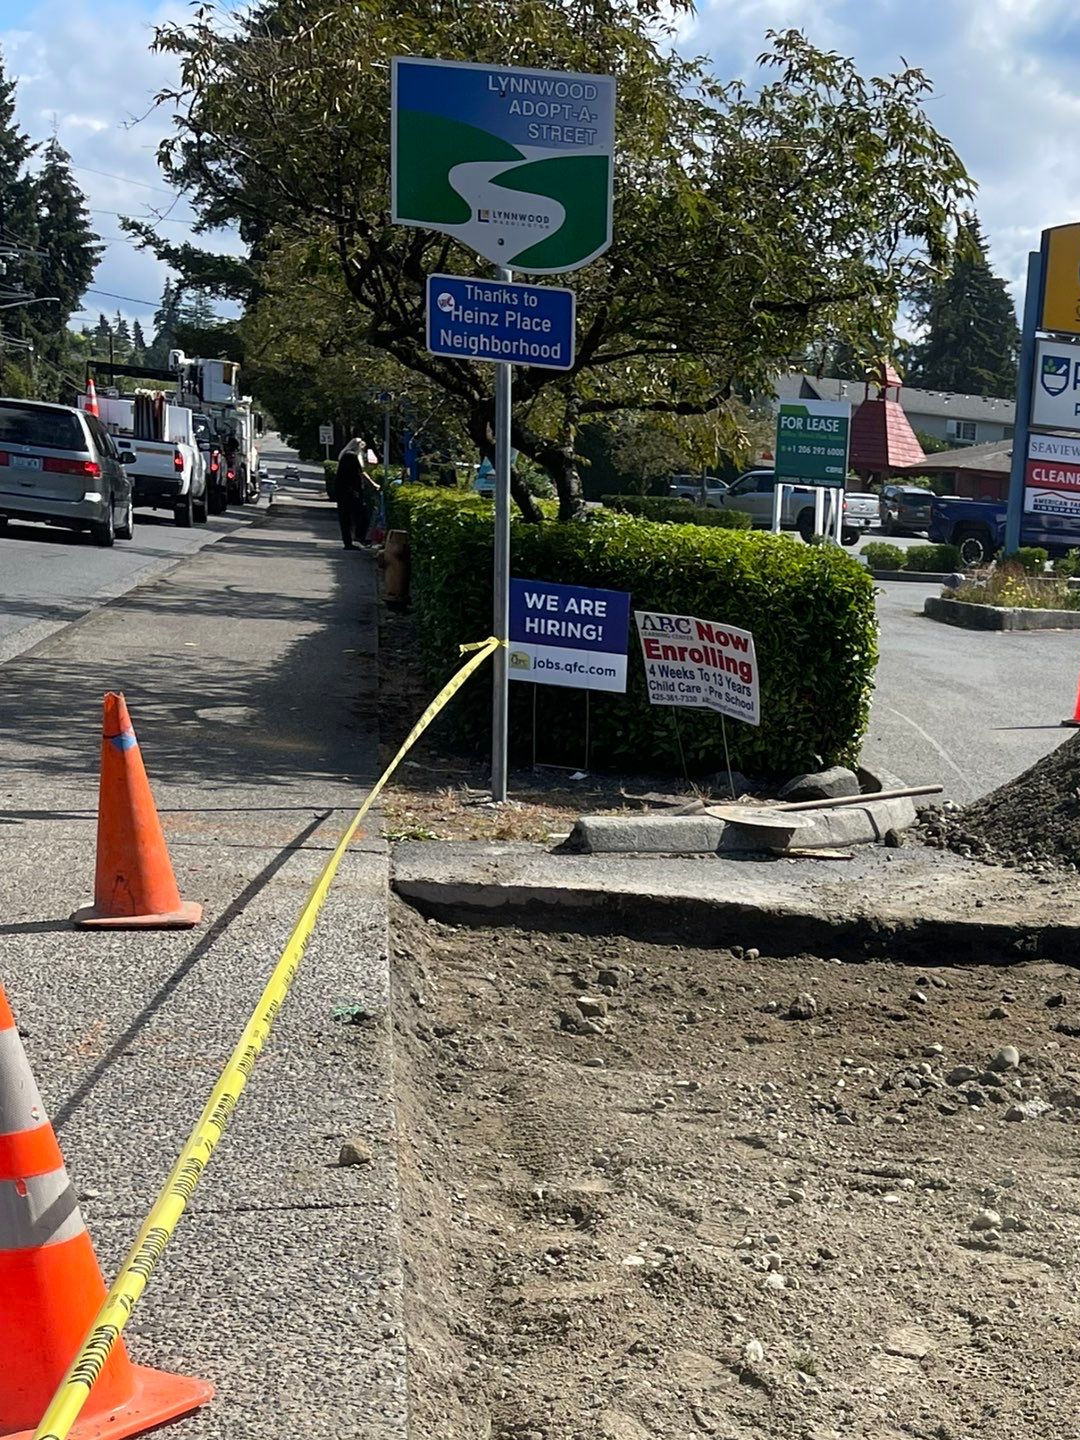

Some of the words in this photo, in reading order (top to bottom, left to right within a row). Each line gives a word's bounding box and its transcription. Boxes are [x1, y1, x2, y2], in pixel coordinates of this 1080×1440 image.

[488, 75, 597, 100] LYNNWOOD
[508, 100, 597, 122] ADOPT-A-
[528, 123, 596, 145] STREET
[493, 211, 549, 223] LYNNWOOD
[465, 285, 518, 306] Thanks
[524, 291, 538, 307] to
[451, 306, 499, 327] Heinz
[505, 313, 551, 332] Place
[440, 330, 561, 359] Neighborhood
[781, 416, 803, 430] FOR
[806, 418, 839, 432] LEASE
[1034, 498, 1068, 506] AMERICAN
[524, 592, 559, 612] WE
[565, 598, 607, 618] ARE
[525, 616, 603, 641] HIRING!
[641, 615, 692, 635] ABC
[672, 633, 694, 641] CENTER
[695, 621, 749, 653] Now
[533, 657, 616, 677] jobs.qfc.com
[643, 638, 753, 684] Enrolling
[649, 664, 656, 677] 4
[658, 664, 695, 680] Weeks
[697, 668, 710, 682] To
[712, 672, 723, 687] 13
[725, 676, 752, 697] Years
[649, 680, 675, 692] Child
[678, 682, 701, 694] Care
[708, 686, 722, 700] Pre
[724, 693, 754, 711] School
